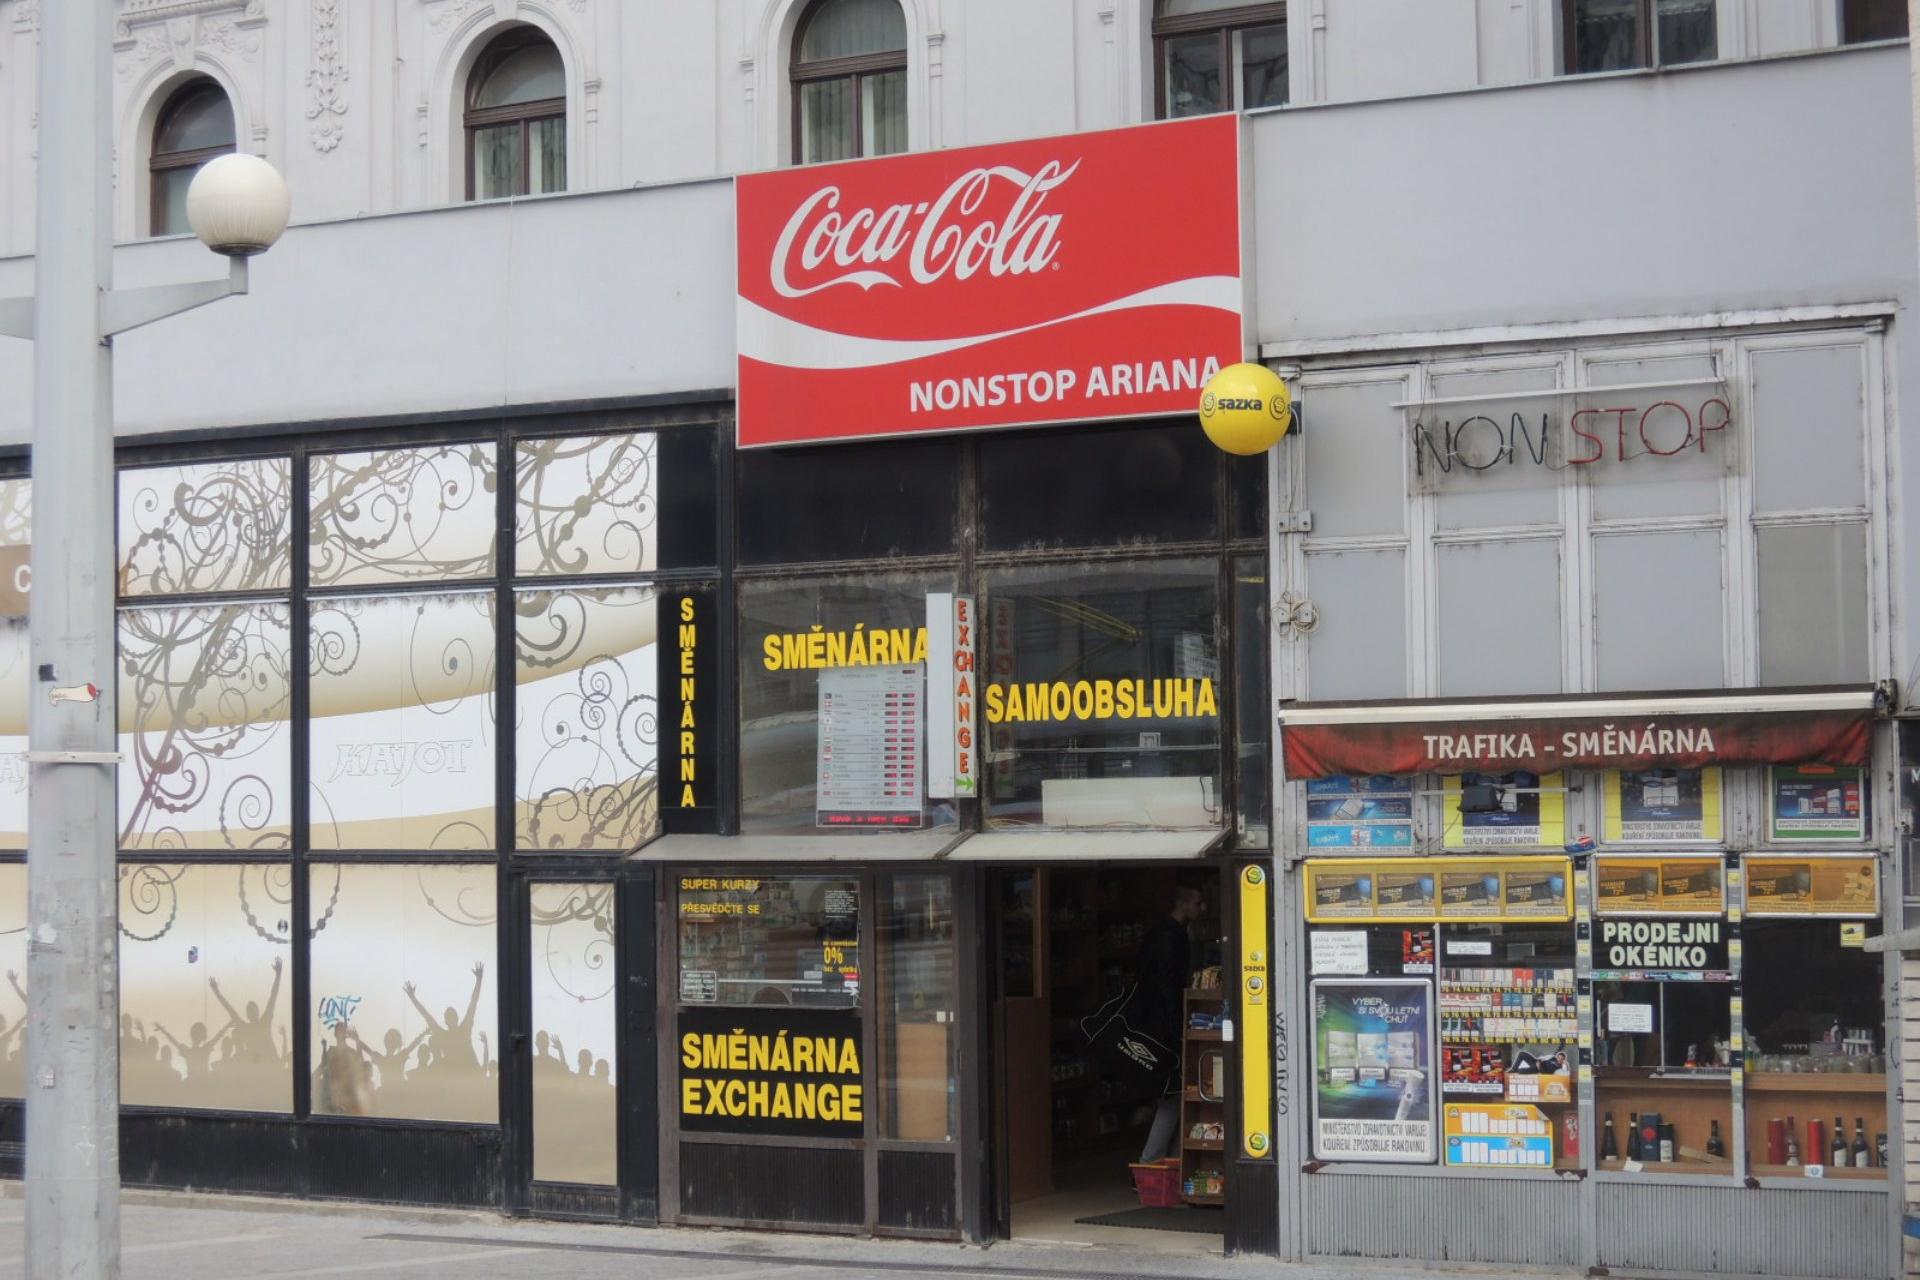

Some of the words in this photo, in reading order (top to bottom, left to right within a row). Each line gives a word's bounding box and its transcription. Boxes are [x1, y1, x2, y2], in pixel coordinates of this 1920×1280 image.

[770, 157, 1082, 298] Coca-Cola
[910, 370, 1076, 412] NONSTOP
[1085, 356, 1221, 398] ARIANA
[1415, 412, 1548, 475] NON
[1568, 399, 1731, 464] STOP
[763, 623, 928, 671] SMĚNÁRNA
[679, 597, 696, 807] SMĚNÁRNA
[954, 600, 974, 774] EXCHANGE
[985, 677, 1217, 724] SAMOOBSLUHA
[1423, 733, 1535, 760] TRAFIKA
[1562, 724, 1715, 757] SMĚNÁRNA
[682, 879, 718, 890] SUPER
[722, 879, 760, 890] KURZY
[747, 904, 760, 914] SE
[1603, 922, 1719, 944] PRODEJNI
[1609, 941, 1706, 967] OKÉNKO
[682, 1028, 860, 1074] SMĚNÁRNA
[682, 1078, 863, 1122] EXCHANGE
